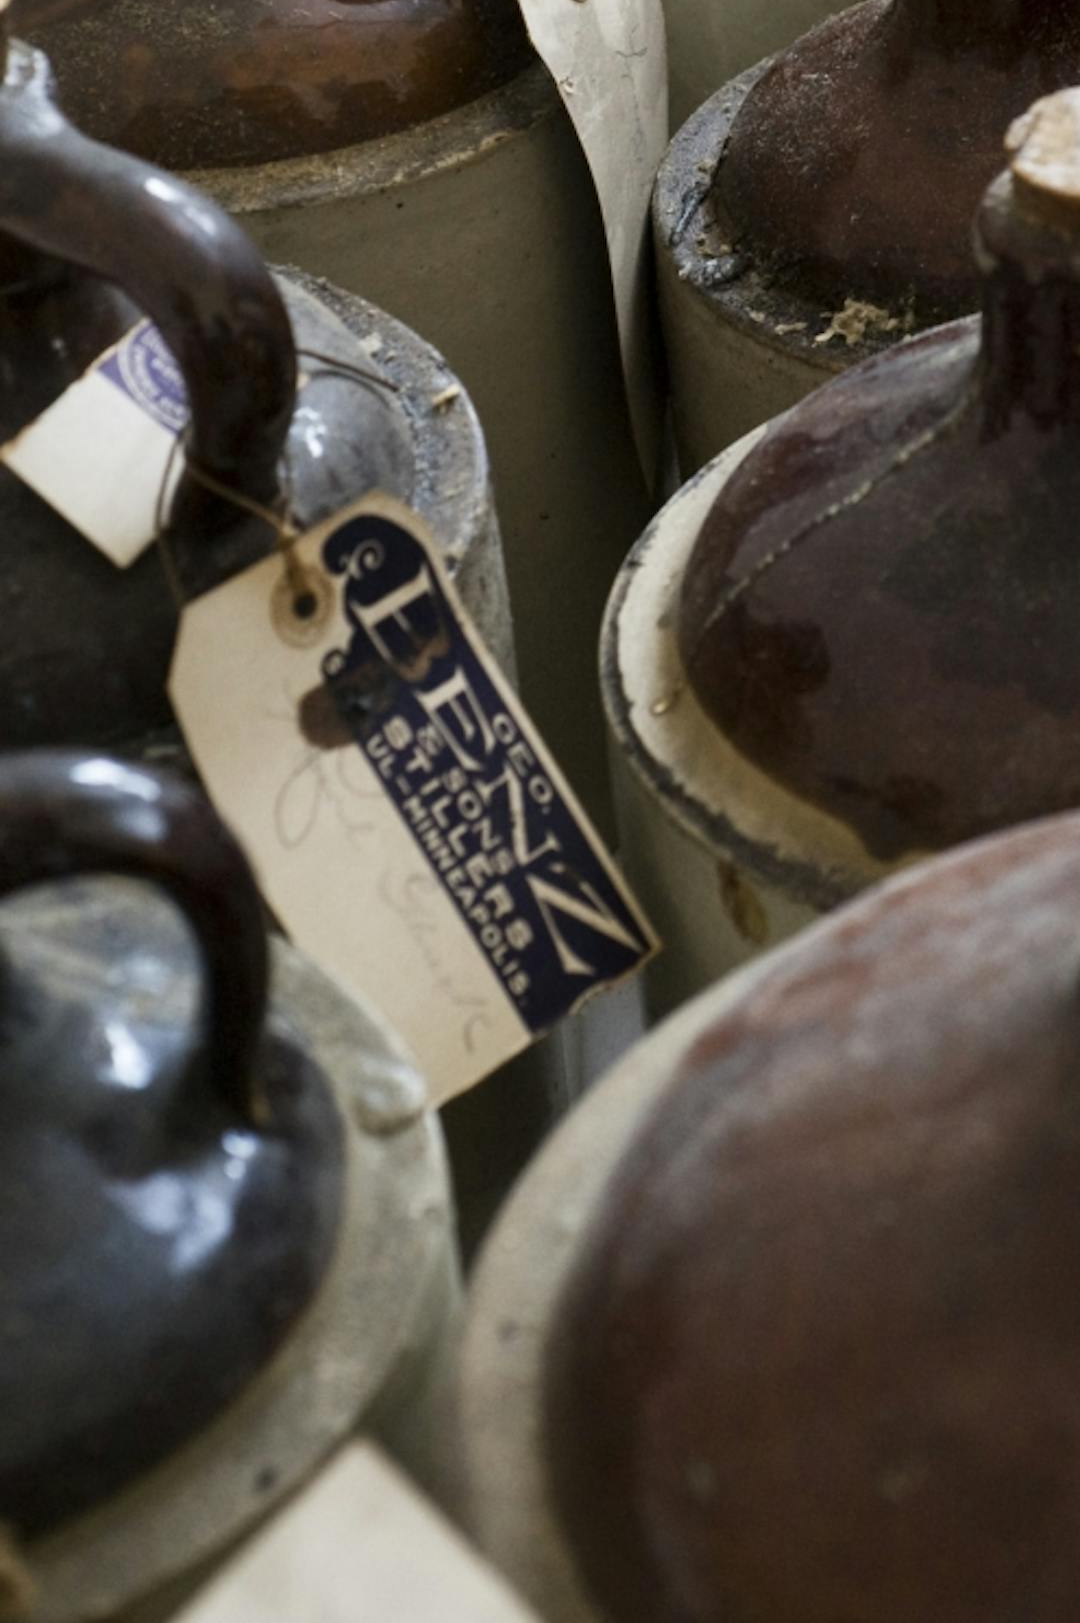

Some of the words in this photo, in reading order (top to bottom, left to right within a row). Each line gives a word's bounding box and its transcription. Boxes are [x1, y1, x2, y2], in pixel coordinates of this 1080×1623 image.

[350, 563, 646, 976] BENZ
[380, 714, 535, 952] STILLERS
[415, 724, 444, 757] &
[441, 764, 516, 875] SONS
